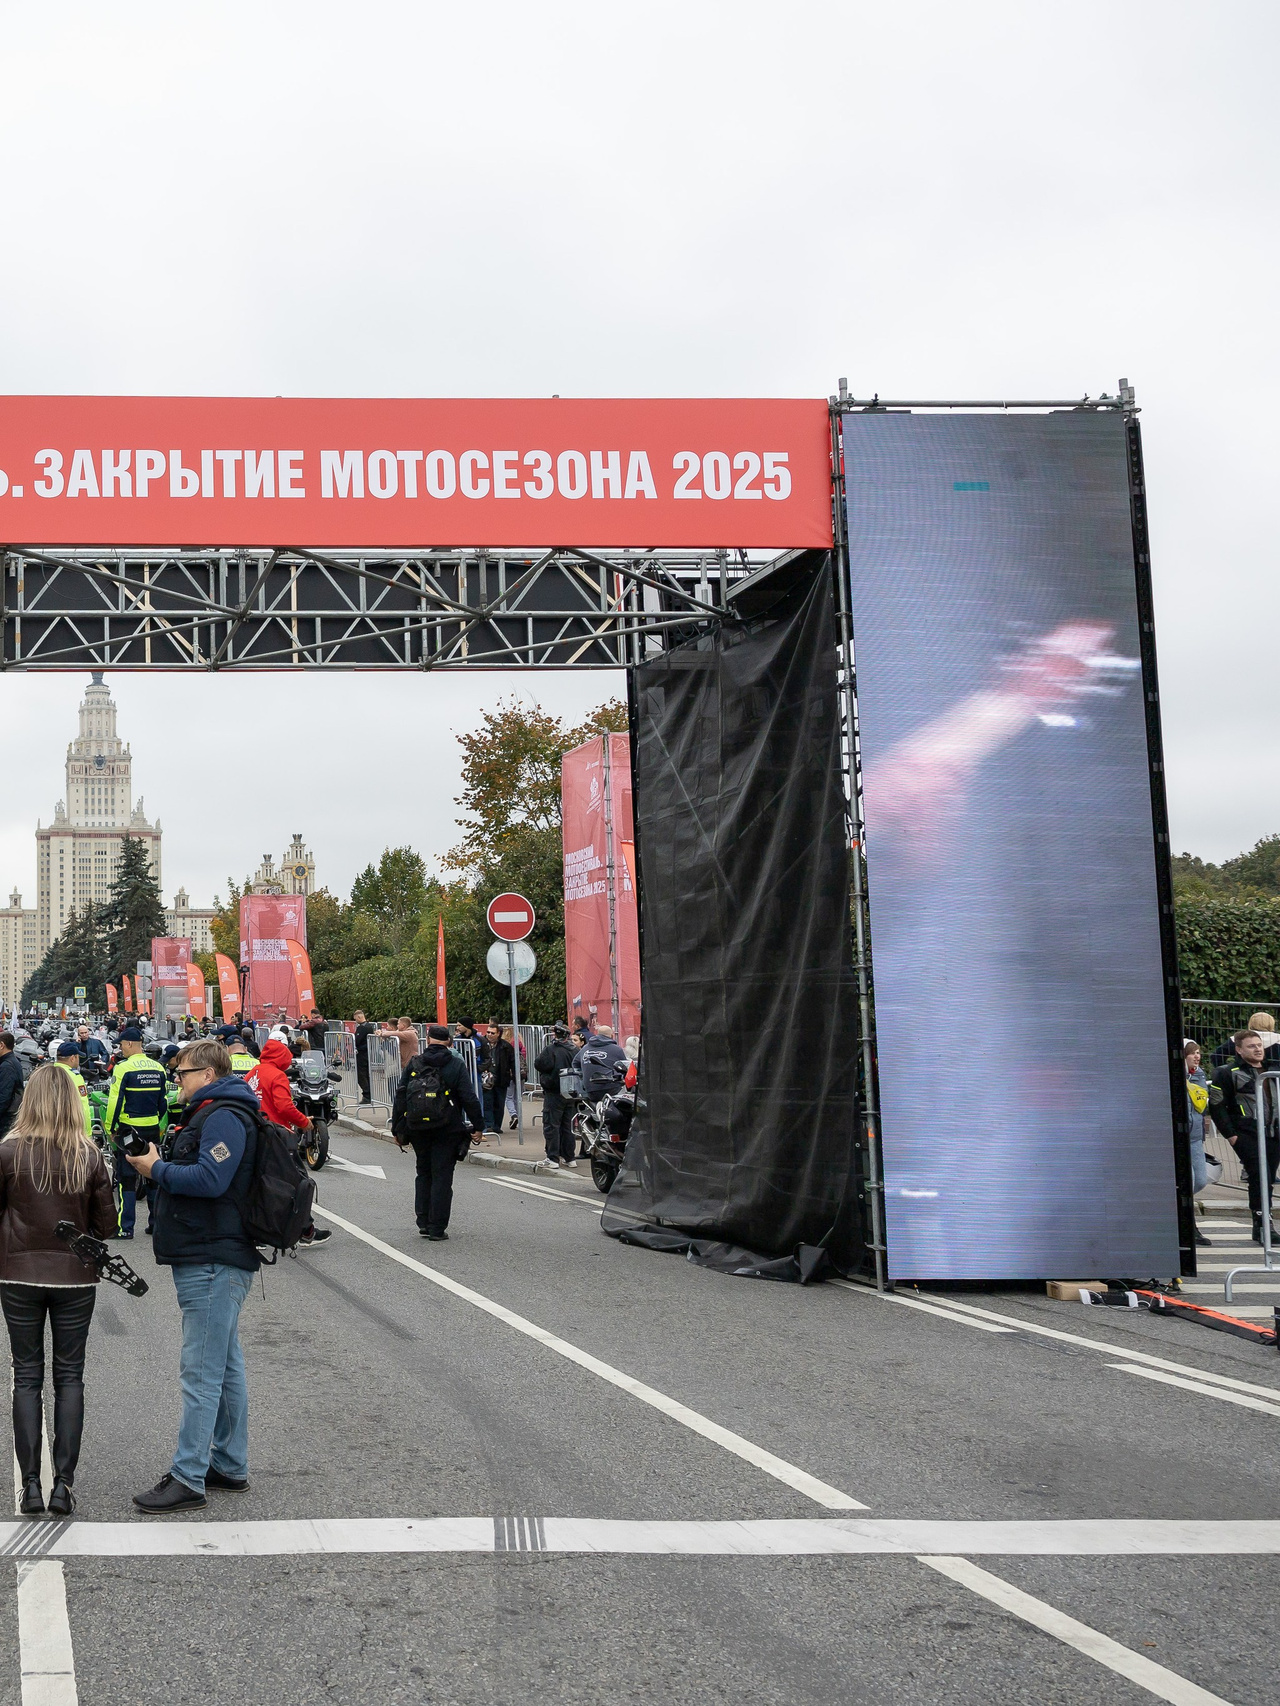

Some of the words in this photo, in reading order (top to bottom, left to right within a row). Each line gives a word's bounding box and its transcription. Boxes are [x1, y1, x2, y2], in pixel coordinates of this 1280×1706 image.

[33, 448, 306, 499] ЗАКРЫТИЕ
[320, 449, 658, 500] МОТОСЕЗОНА
[672, 450, 792, 501] 2025
